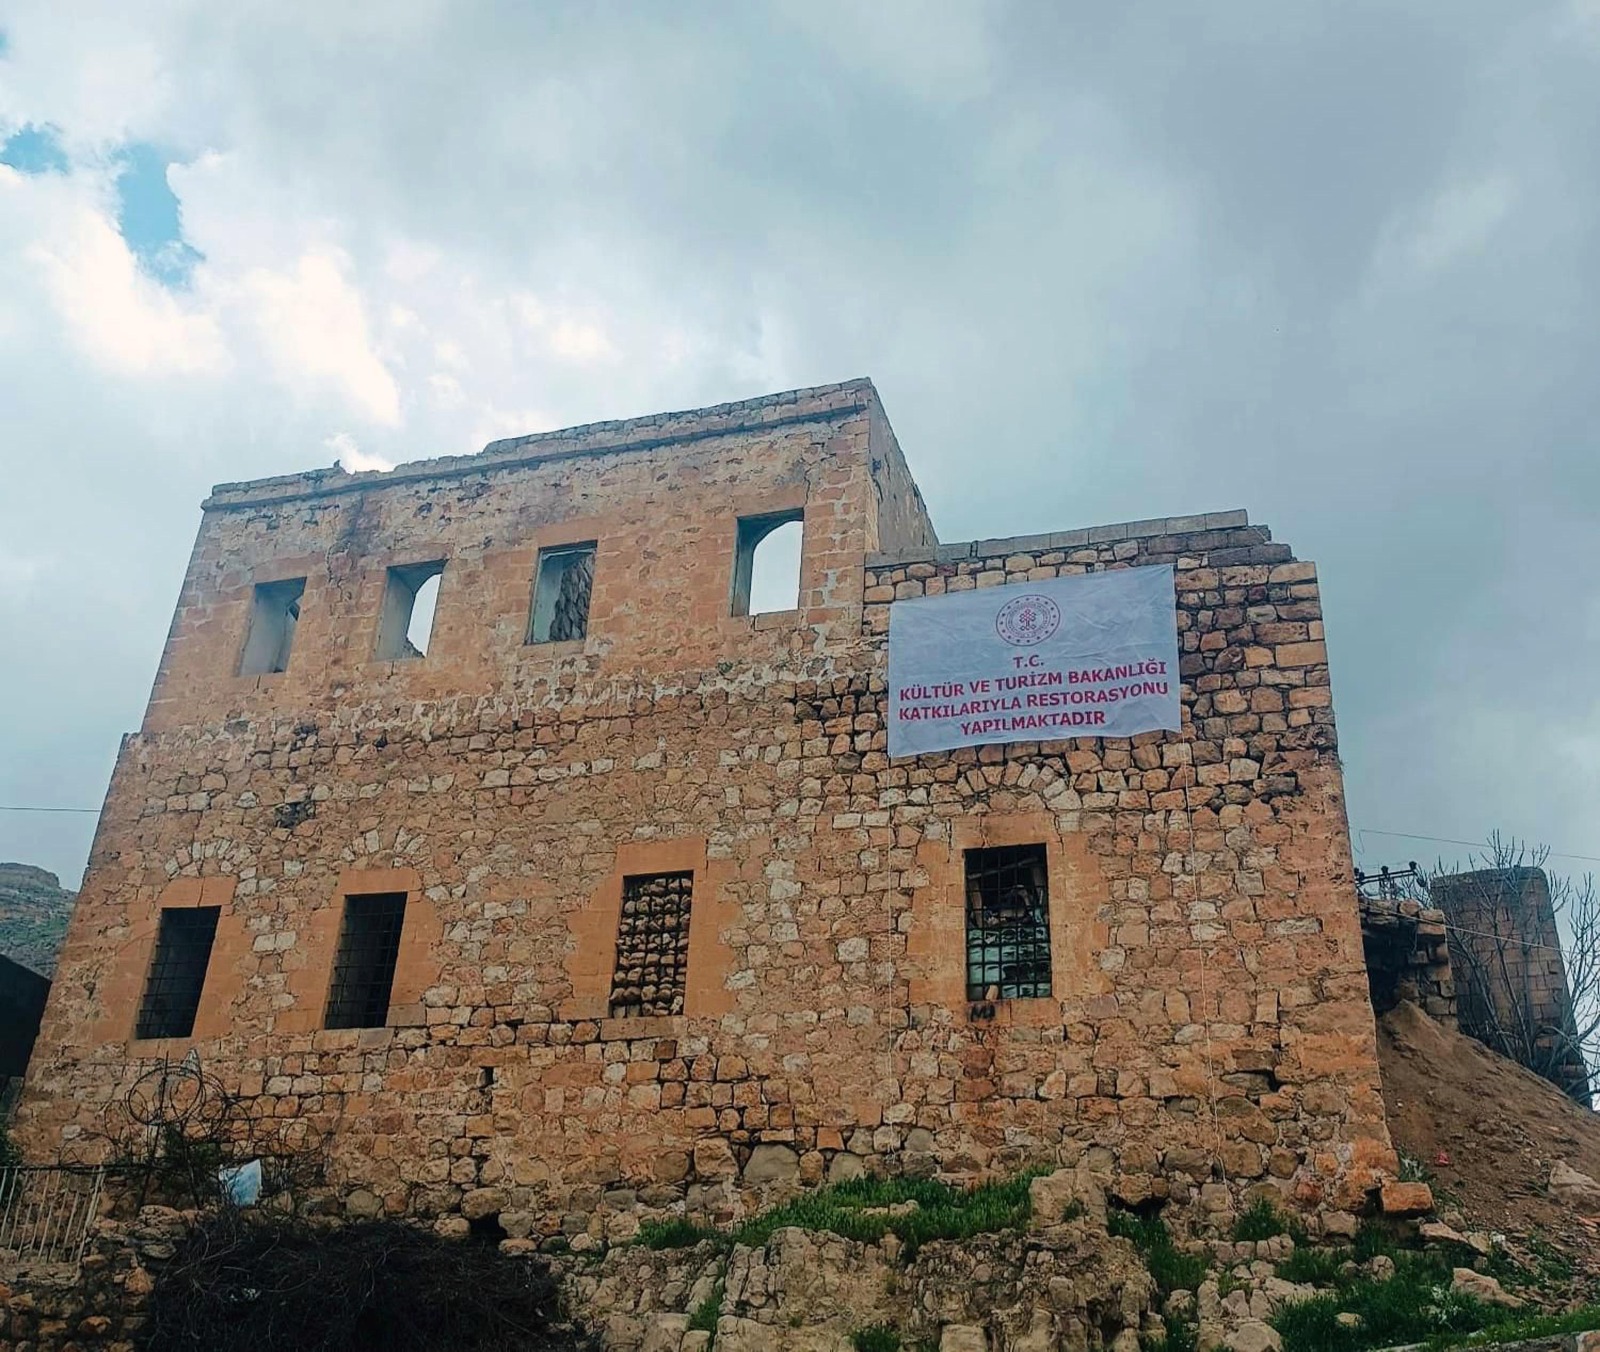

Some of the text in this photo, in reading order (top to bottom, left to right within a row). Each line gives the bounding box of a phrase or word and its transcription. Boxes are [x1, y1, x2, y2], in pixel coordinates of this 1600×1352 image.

[1013, 655, 1044, 668] T.C.
[900, 658, 1166, 701] KÜLTÜR VE TURİZM BAKANLIĞI
[899, 682, 1169, 720] KATKILARIYLA RESTORASYONU
[961, 711, 1105, 735] YAPILMAKTADIR
